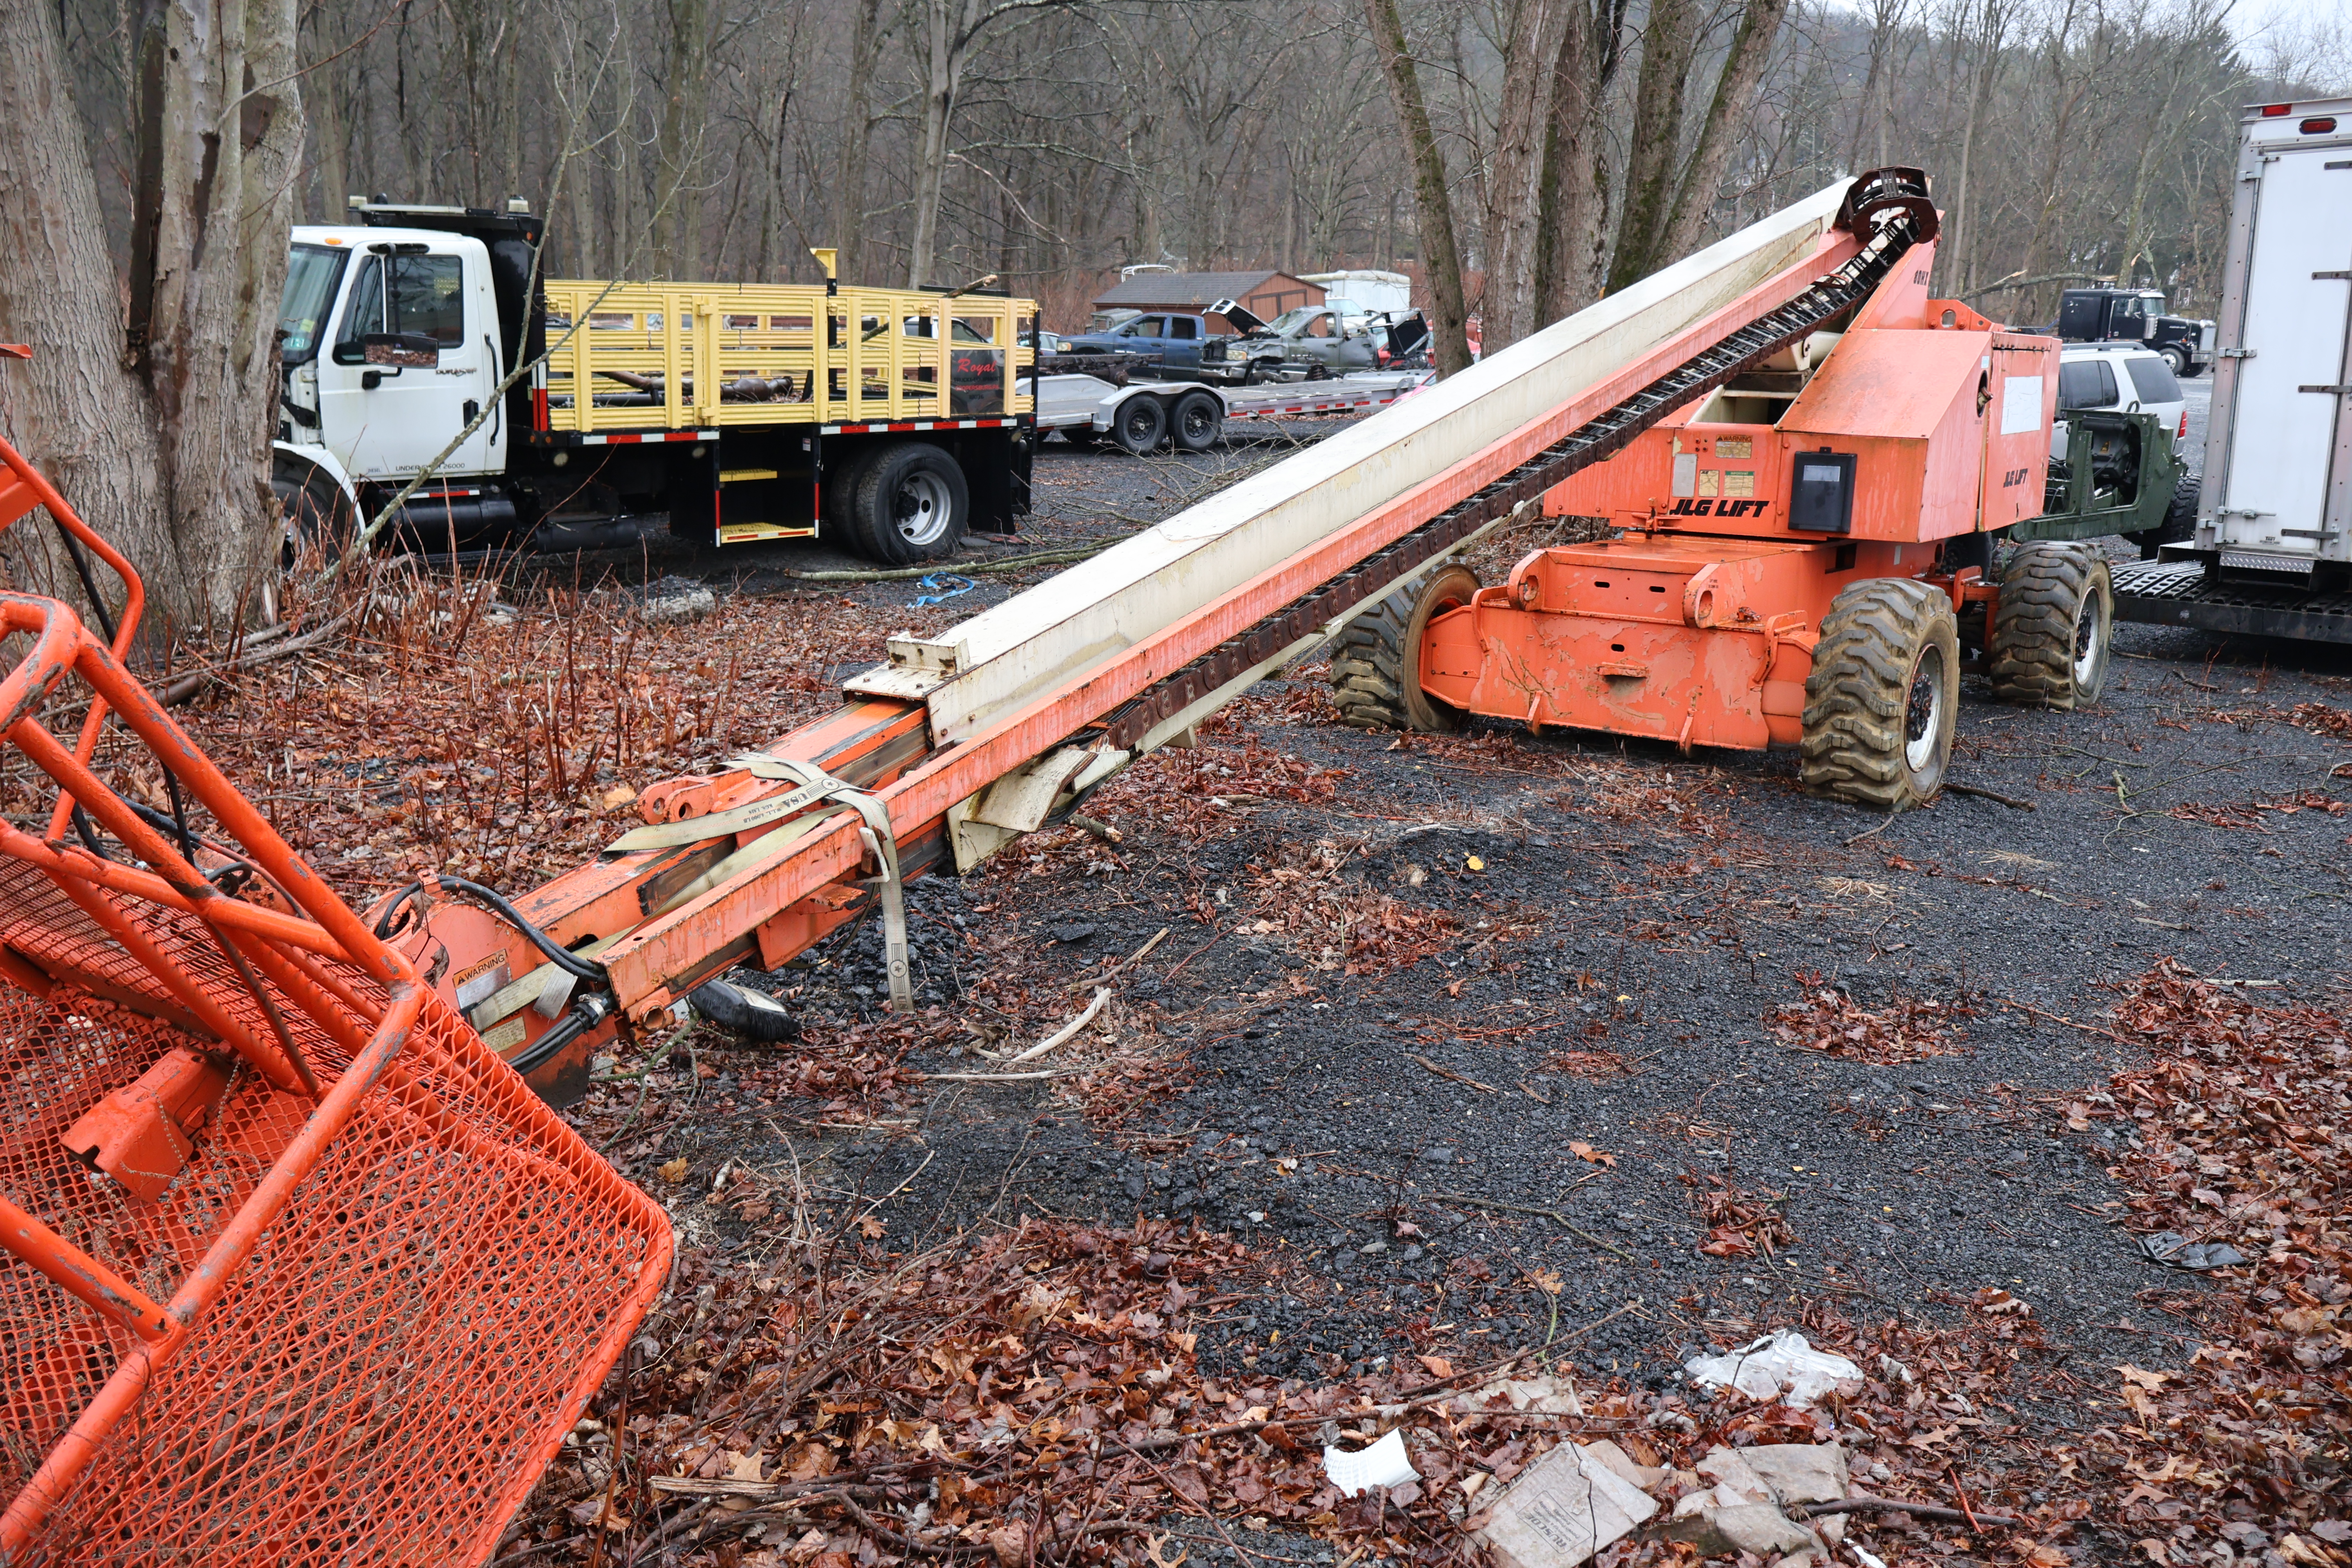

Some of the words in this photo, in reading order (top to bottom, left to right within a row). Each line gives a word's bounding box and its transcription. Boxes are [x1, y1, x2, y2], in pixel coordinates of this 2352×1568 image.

[957, 358, 997, 376] Royal
[1669, 499, 1713, 516] JLG
[1714, 500, 1770, 517] LIFT
[781, 793, 809, 808] USA
[464, 954, 505, 980] WARNING
[897, 995, 909, 1010] US
[1524, 1512, 1567, 1548] RUSCOE
